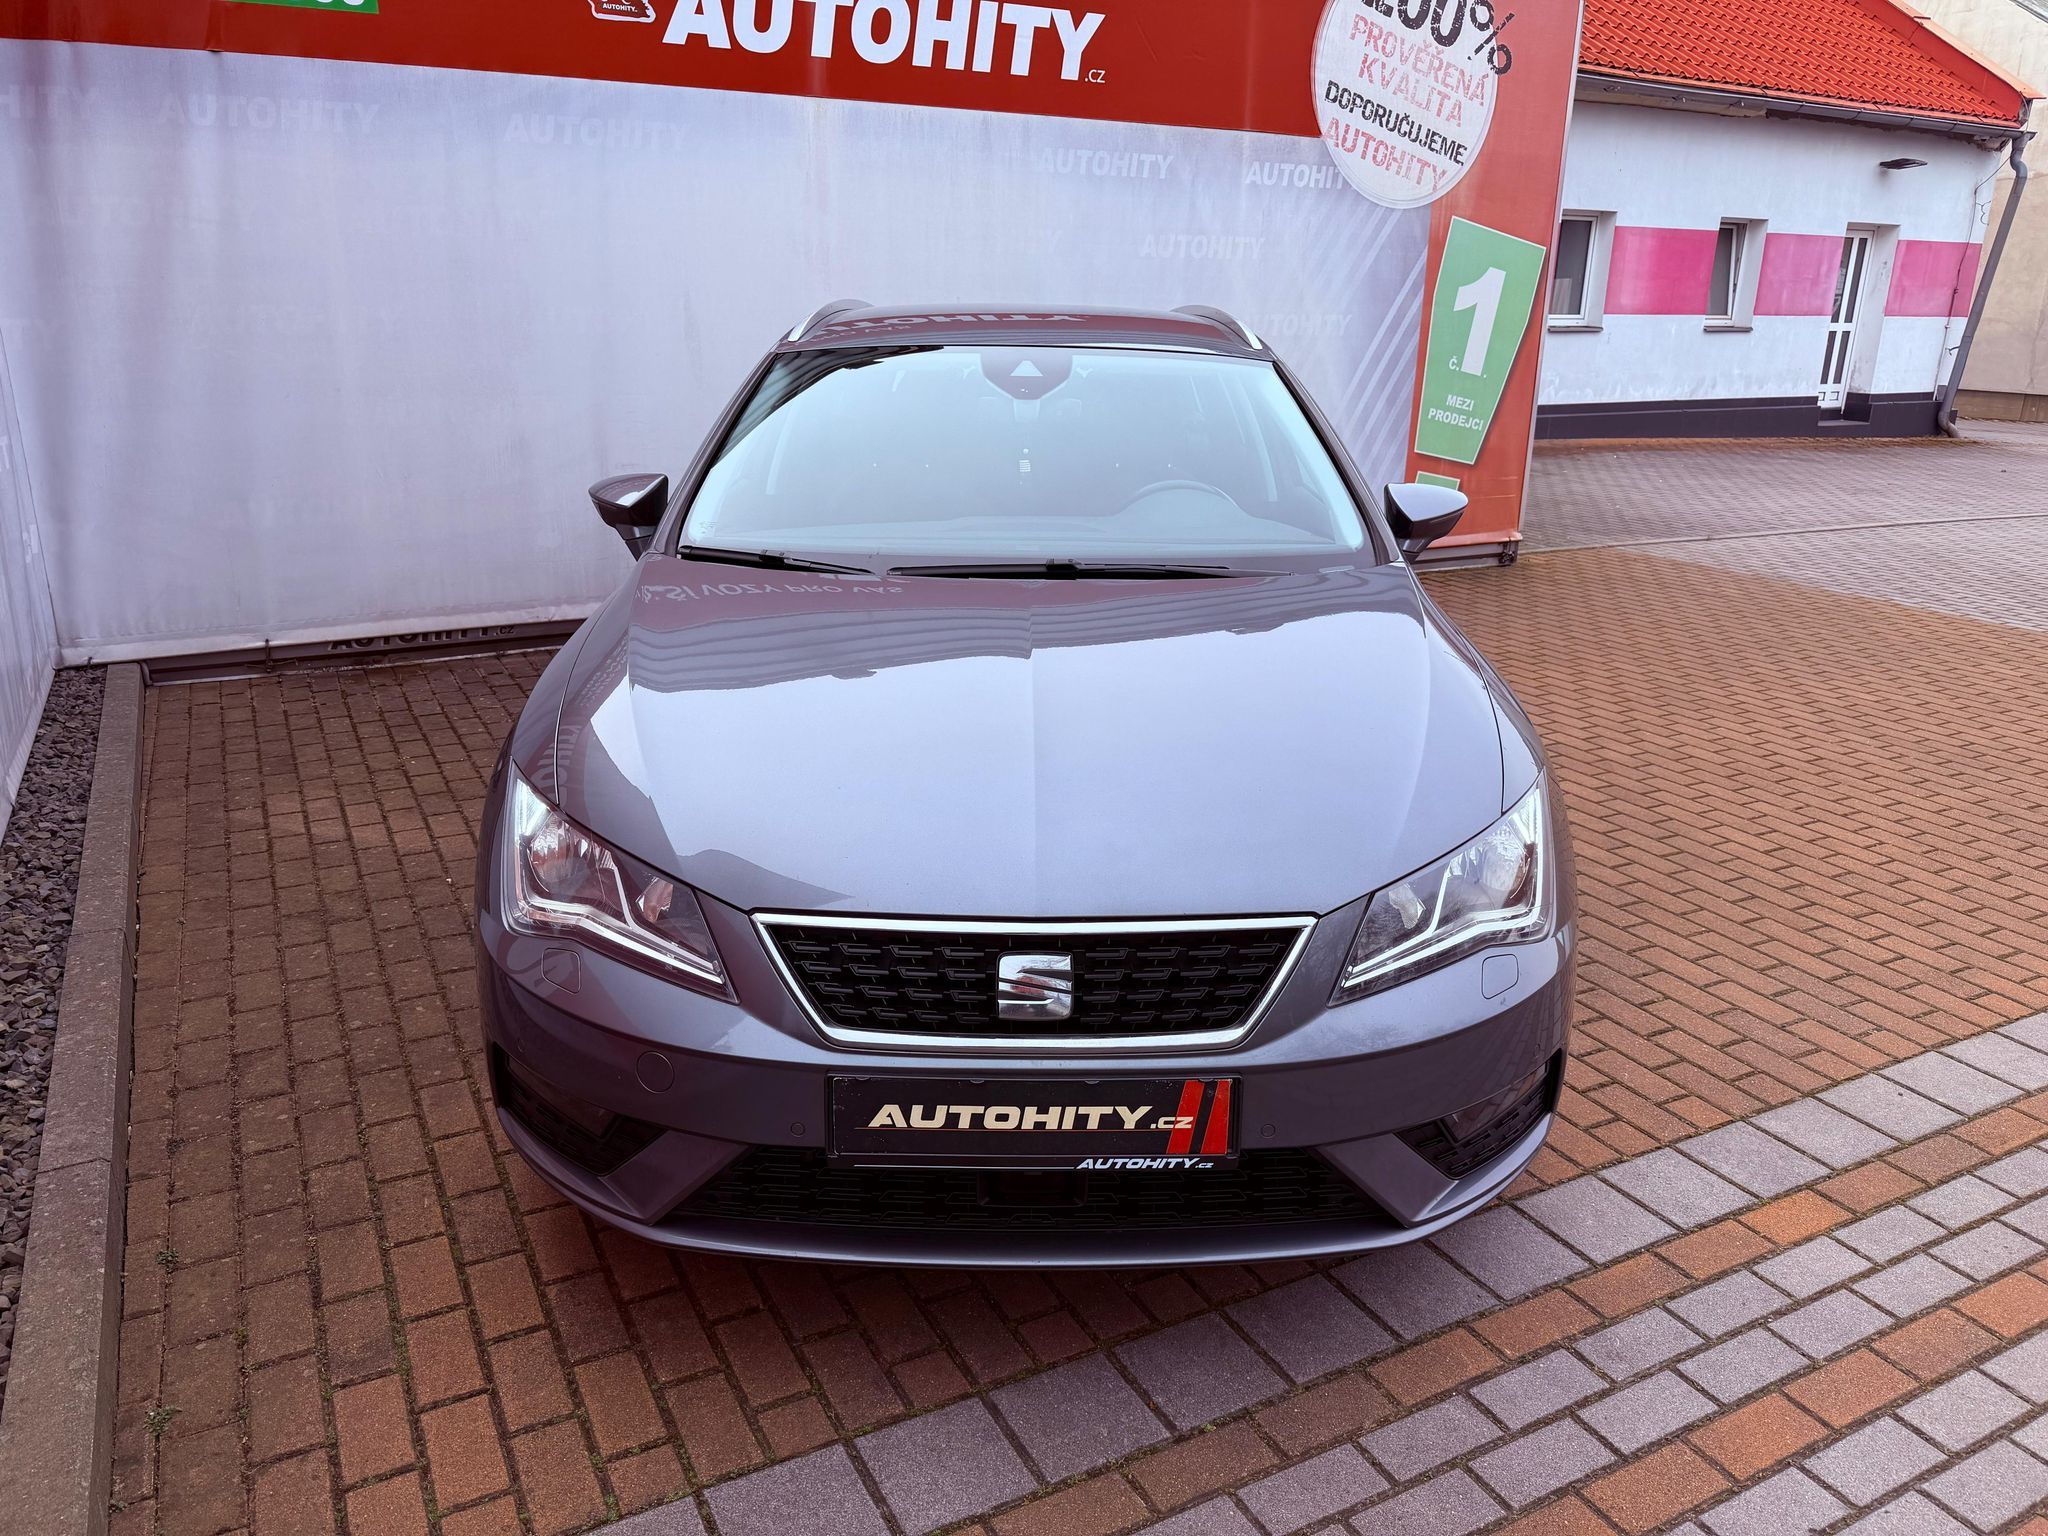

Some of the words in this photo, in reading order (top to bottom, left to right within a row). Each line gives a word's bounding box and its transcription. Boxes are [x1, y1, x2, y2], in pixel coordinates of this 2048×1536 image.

[1358, 53, 1463, 127] KVALITA
[1325, 80, 1468, 166] DOPORUČUJEME
[1040, 148, 1174, 178] AUTOHITY
[1324, 117, 1447, 194] AUTOHITY
[1139, 234, 1266, 260] AUTOHITY
[1446, 394, 1475, 411] MEZI
[1428, 408, 1484, 431] PRODEJCI
